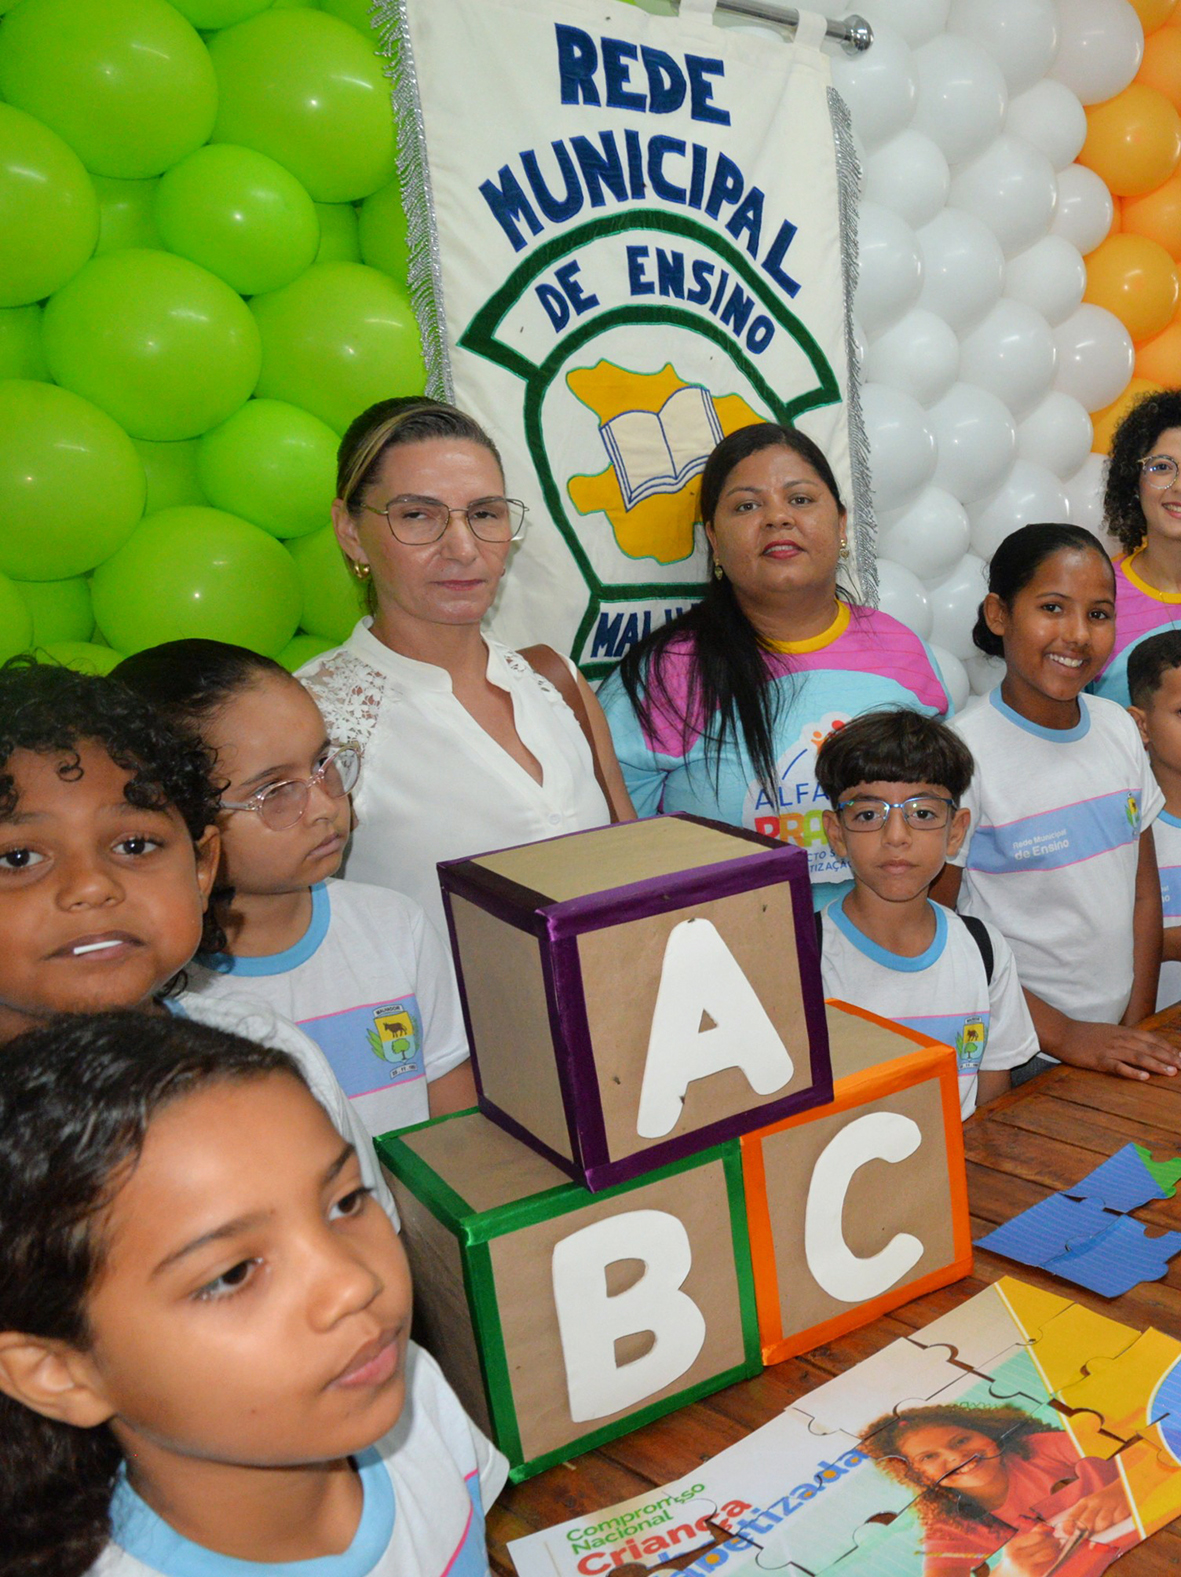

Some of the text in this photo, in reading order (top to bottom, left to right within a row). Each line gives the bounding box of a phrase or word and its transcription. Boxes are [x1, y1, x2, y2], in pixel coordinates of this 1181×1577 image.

[554, 22, 731, 126] REDE
[478, 129, 802, 299] MUNICIPAL
[534, 245, 776, 355] DE ENSINO
[1014, 839, 1069, 860] de Ensino
[637, 918, 795, 1138] A
[805, 1111, 924, 1303] C
[552, 1210, 706, 1424] B
[572, 1510, 674, 1555] Nacional
